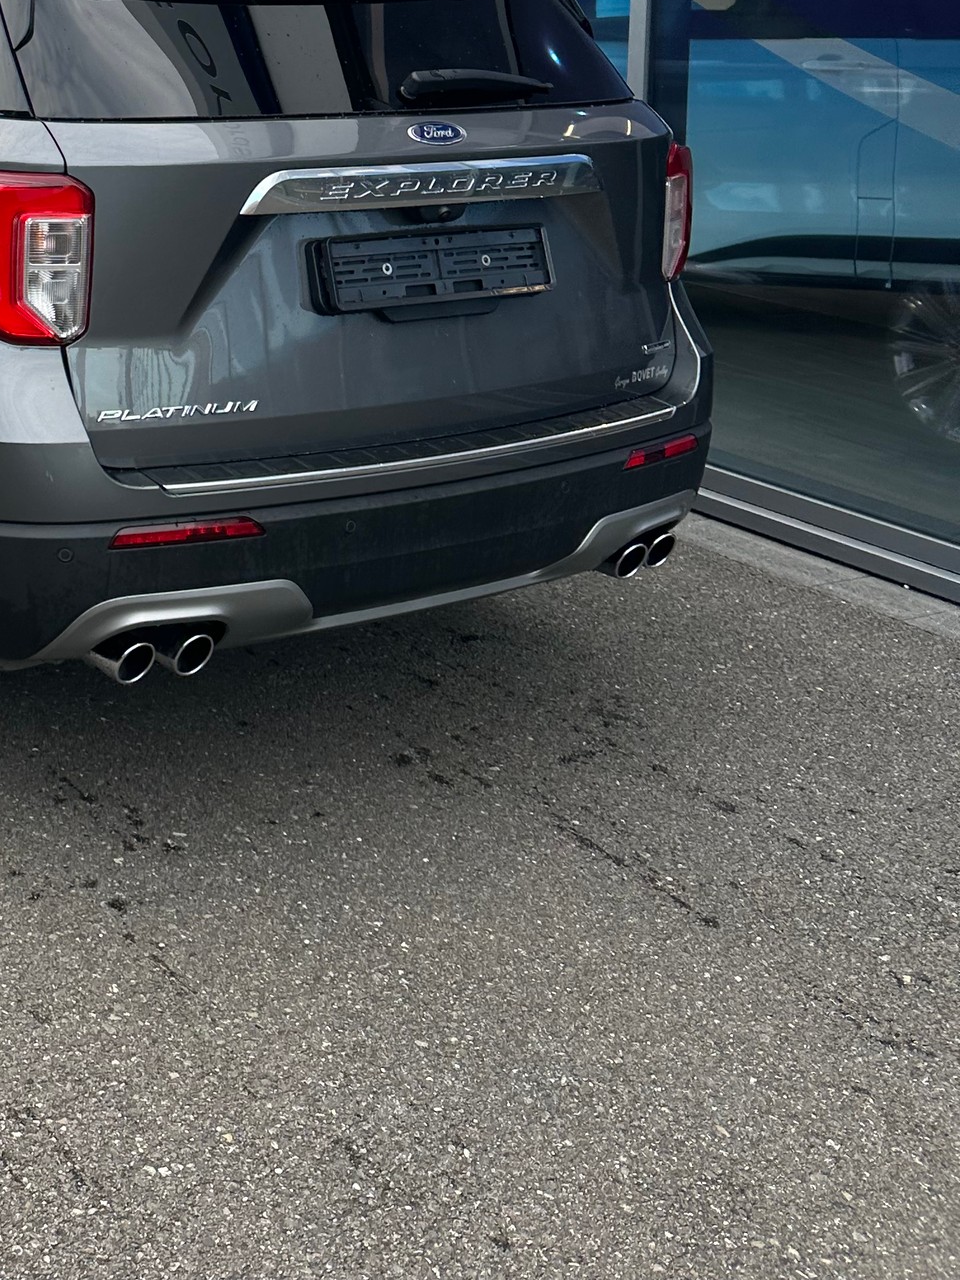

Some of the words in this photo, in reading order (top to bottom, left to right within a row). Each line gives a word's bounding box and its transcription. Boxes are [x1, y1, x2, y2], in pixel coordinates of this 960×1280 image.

[320, 170, 557, 200] EXPLORER
[632, 366, 655, 382] BOVET
[97, 400, 259, 422] PLATINUM
